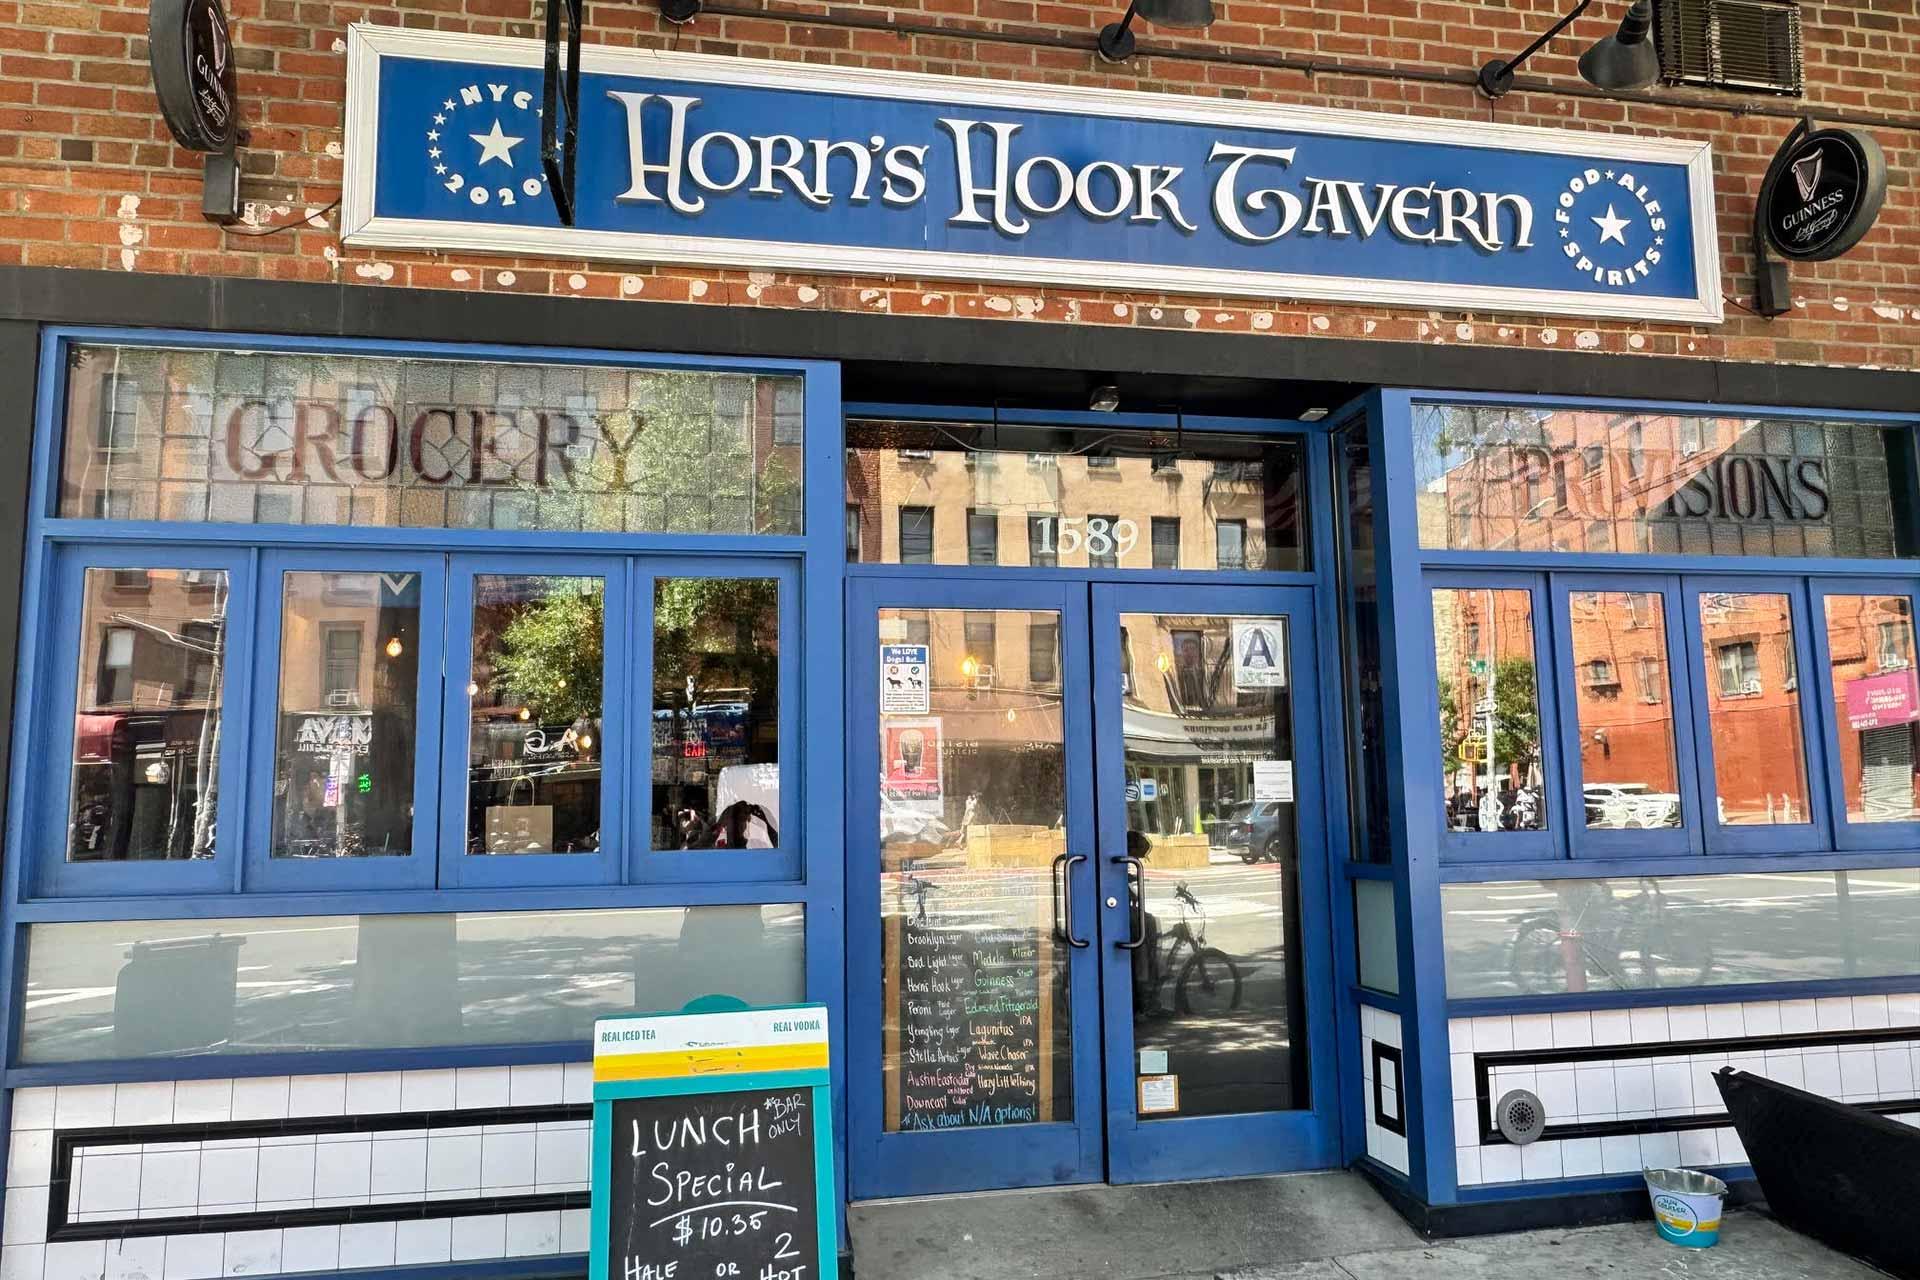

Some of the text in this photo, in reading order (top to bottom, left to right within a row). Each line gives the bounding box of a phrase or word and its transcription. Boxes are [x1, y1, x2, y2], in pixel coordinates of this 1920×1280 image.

[460, 84, 533, 110] NYC
[606, 90, 1535, 252] HORN'S HOOK TAVERN
[444, 173, 542, 206] 2020
[1555, 168, 1600, 224] FOOD
[1617, 173, 1666, 232] ALES
[1782, 188, 1844, 231] GUINNESS
[1563, 241, 1661, 286] SPIRITS
[226, 399, 648, 494] GROCERY
[1036, 517, 1139, 557] 1589
[1242, 628, 1276, 667] A
[907, 931, 945, 951] Brooklyn
[907, 955, 926, 968] Bud
[927, 955, 947, 974] Light
[931, 976, 951, 993] Hook
[773, 1020, 821, 1033] REAL VODKA
[969, 1020, 1015, 1039] Lagunitas
[1020, 1015, 1033, 1025] IPA
[601, 1029, 656, 1042] REAL ICED TEA
[909, 1047, 937, 1063] Stella
[907, 1070, 937, 1087] Austin
[767, 1112, 802, 1139] ONLY
[937, 1110, 965, 1127] about
[631, 1108, 761, 1157] LUNCH
[773, 1233, 801, 1259] 2
[716, 1262, 741, 1277] OR
